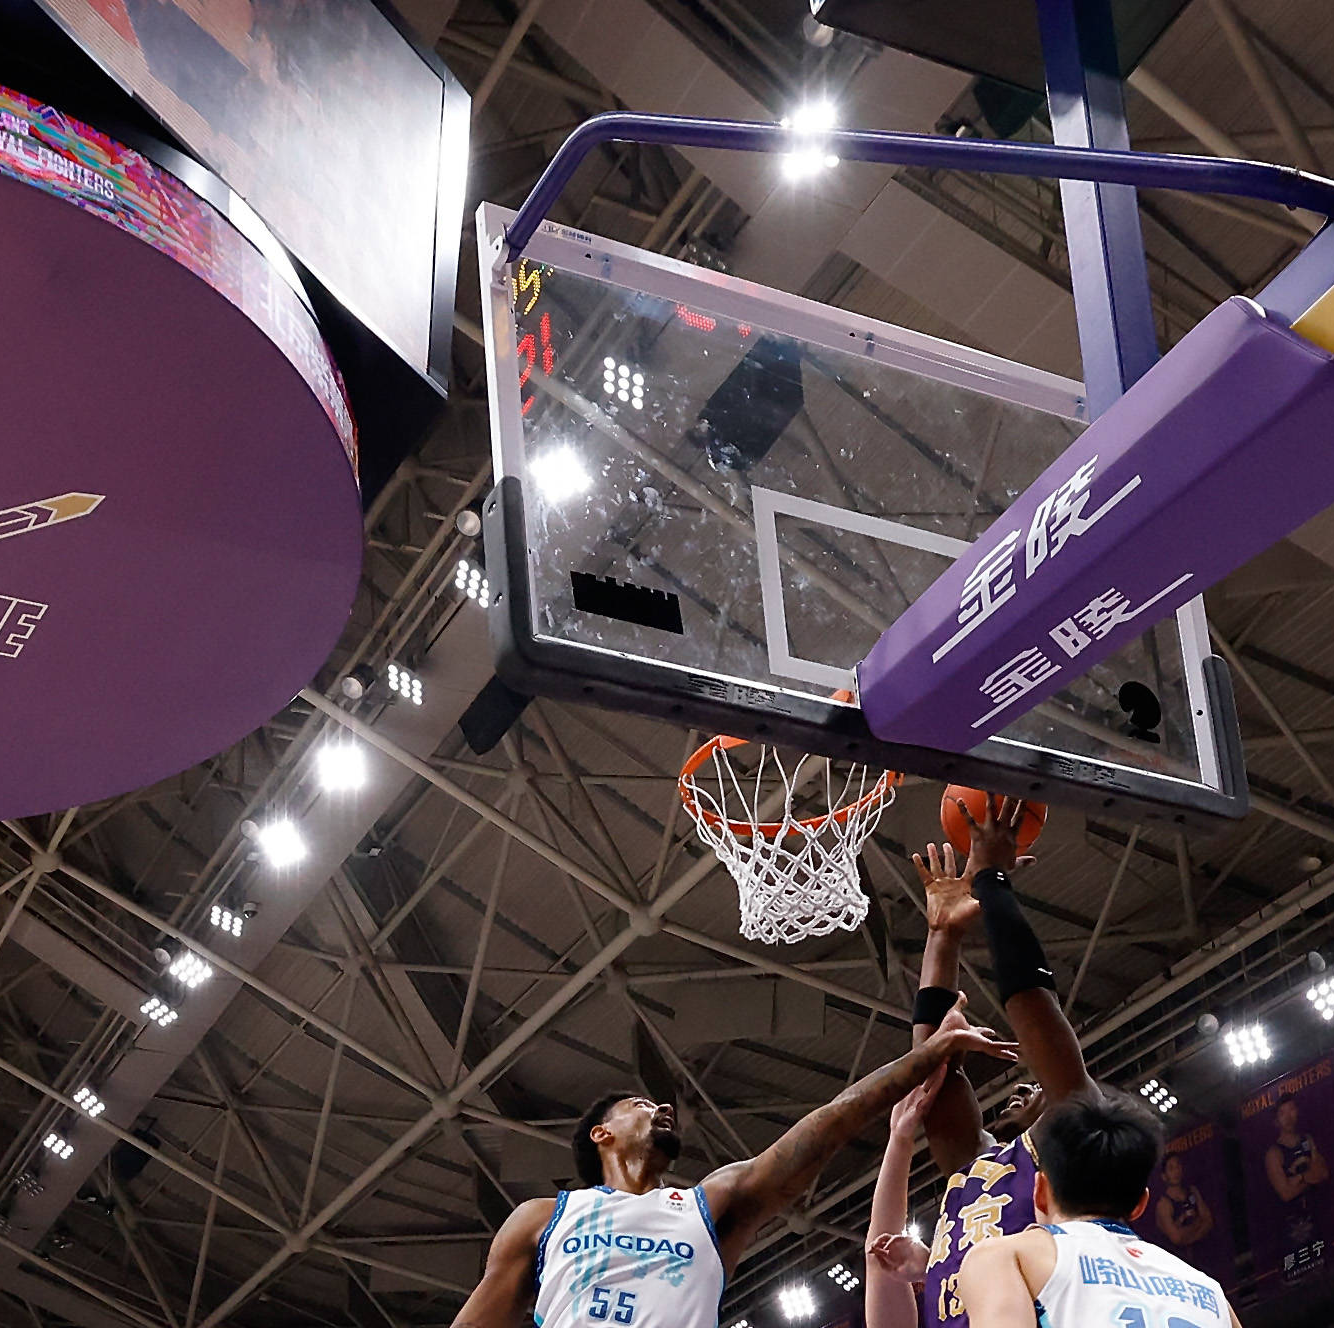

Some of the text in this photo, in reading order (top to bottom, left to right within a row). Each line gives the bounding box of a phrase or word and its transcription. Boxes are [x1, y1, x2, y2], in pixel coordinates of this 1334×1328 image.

[38, 145, 115, 200] FIGHTERS
[932, 453, 1142, 664] 金陵
[970, 572, 1194, 729] 金陵
[562, 1233, 695, 1260] QINGDAO
[588, 1287, 637, 1326] 55
[1078, 1254, 1221, 1320] 崂山啤酒
